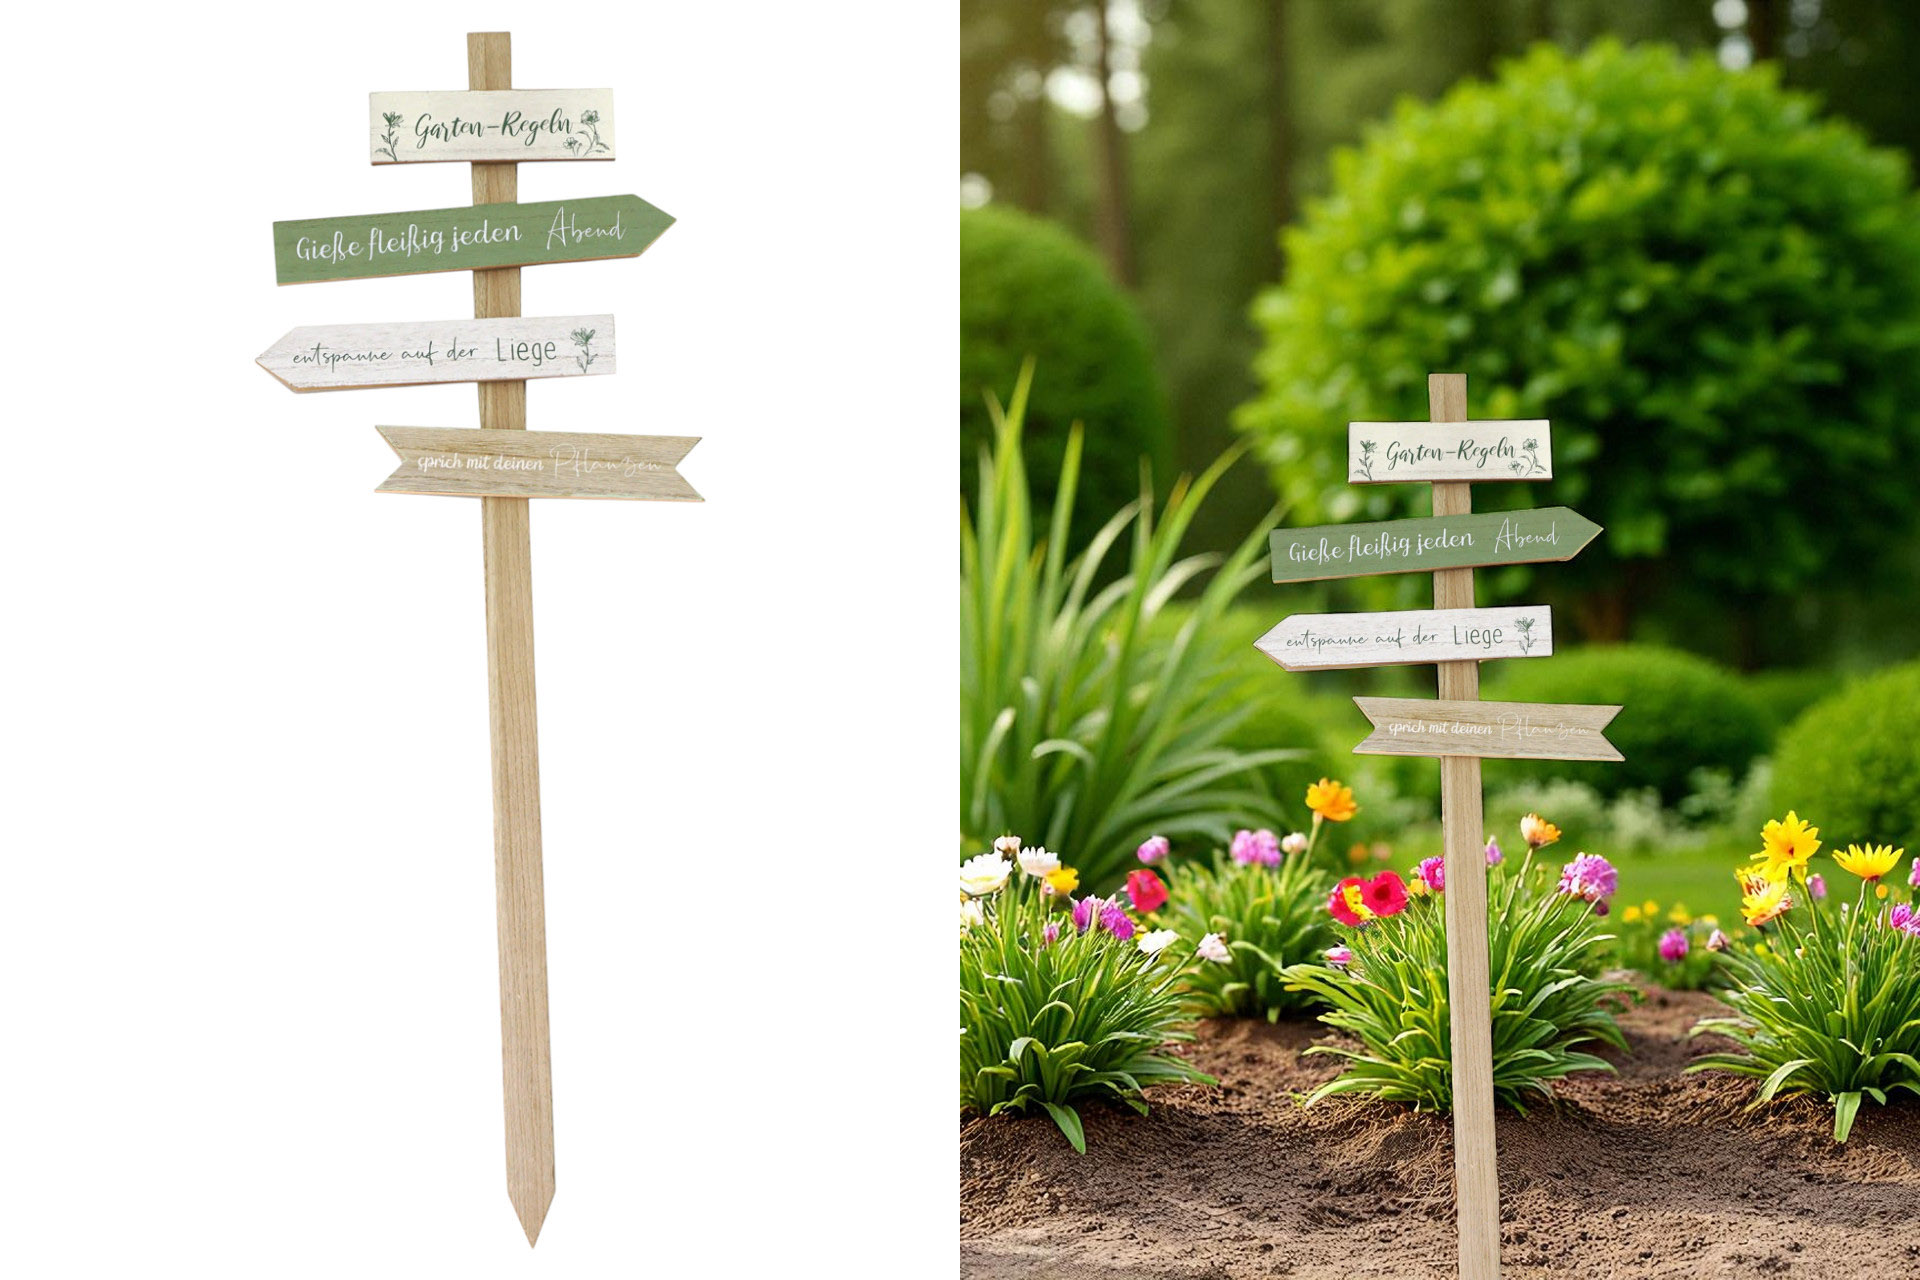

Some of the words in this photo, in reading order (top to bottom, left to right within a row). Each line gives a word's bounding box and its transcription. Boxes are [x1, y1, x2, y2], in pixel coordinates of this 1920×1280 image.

[415, 108, 573, 149] Garten-Regeln
[296, 235, 364, 265] Gieße
[367, 222, 443, 261] fleißig
[451, 220, 522, 253] jeden
[545, 206, 626, 250] Abend
[292, 342, 393, 373] entspanne
[401, 342, 438, 369] auf
[446, 337, 479, 361] der
[497, 337, 557, 367] Liege
[417, 452, 463, 472] sprich
[466, 454, 489, 470] mit
[493, 454, 544, 471] deinen
[550, 444, 662, 478] Pflanzen
[1386, 436, 1516, 470] Garten-Regeln
[1289, 539, 1344, 566] Gieße
[1348, 528, 1410, 562] fleißig
[1416, 529, 1475, 555] jeden
[1494, 517, 1560, 553] Abend
[1286, 629, 1368, 654] entspanne
[1376, 628, 1406, 647] auf
[1413, 625, 1438, 644] der
[1454, 625, 1504, 649] Liege
[1389, 721, 1426, 737] sprich
[1429, 723, 1448, 735] mit
[1450, 723, 1492, 735] deinen
[1497, 715, 1589, 741] Pflanzen
